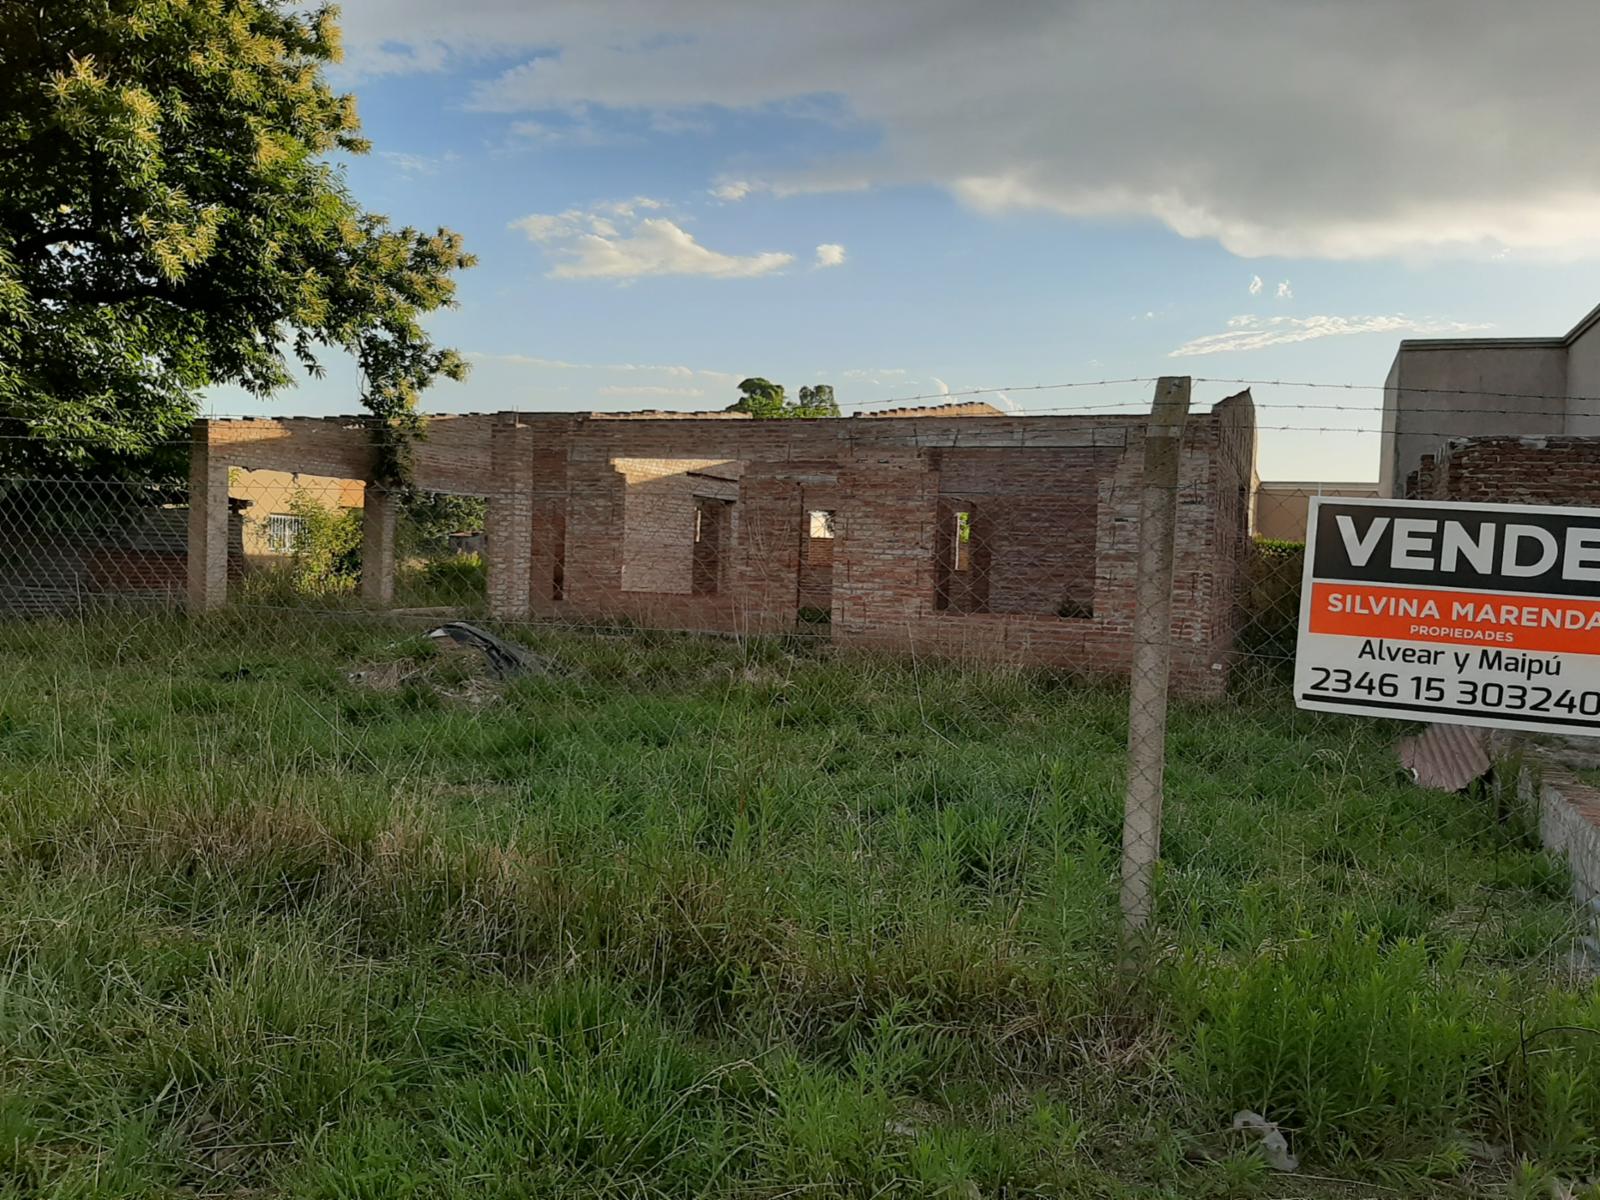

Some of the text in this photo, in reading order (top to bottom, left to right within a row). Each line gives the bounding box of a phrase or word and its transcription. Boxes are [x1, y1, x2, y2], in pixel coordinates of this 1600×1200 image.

[1327, 593, 1440, 620] SILVINA
[1410, 625, 1514, 642] PROPIEDADES
[1358, 639, 1561, 681] Alvear y Maipú
[1310, 667, 1600, 716] 2346 15 303240
